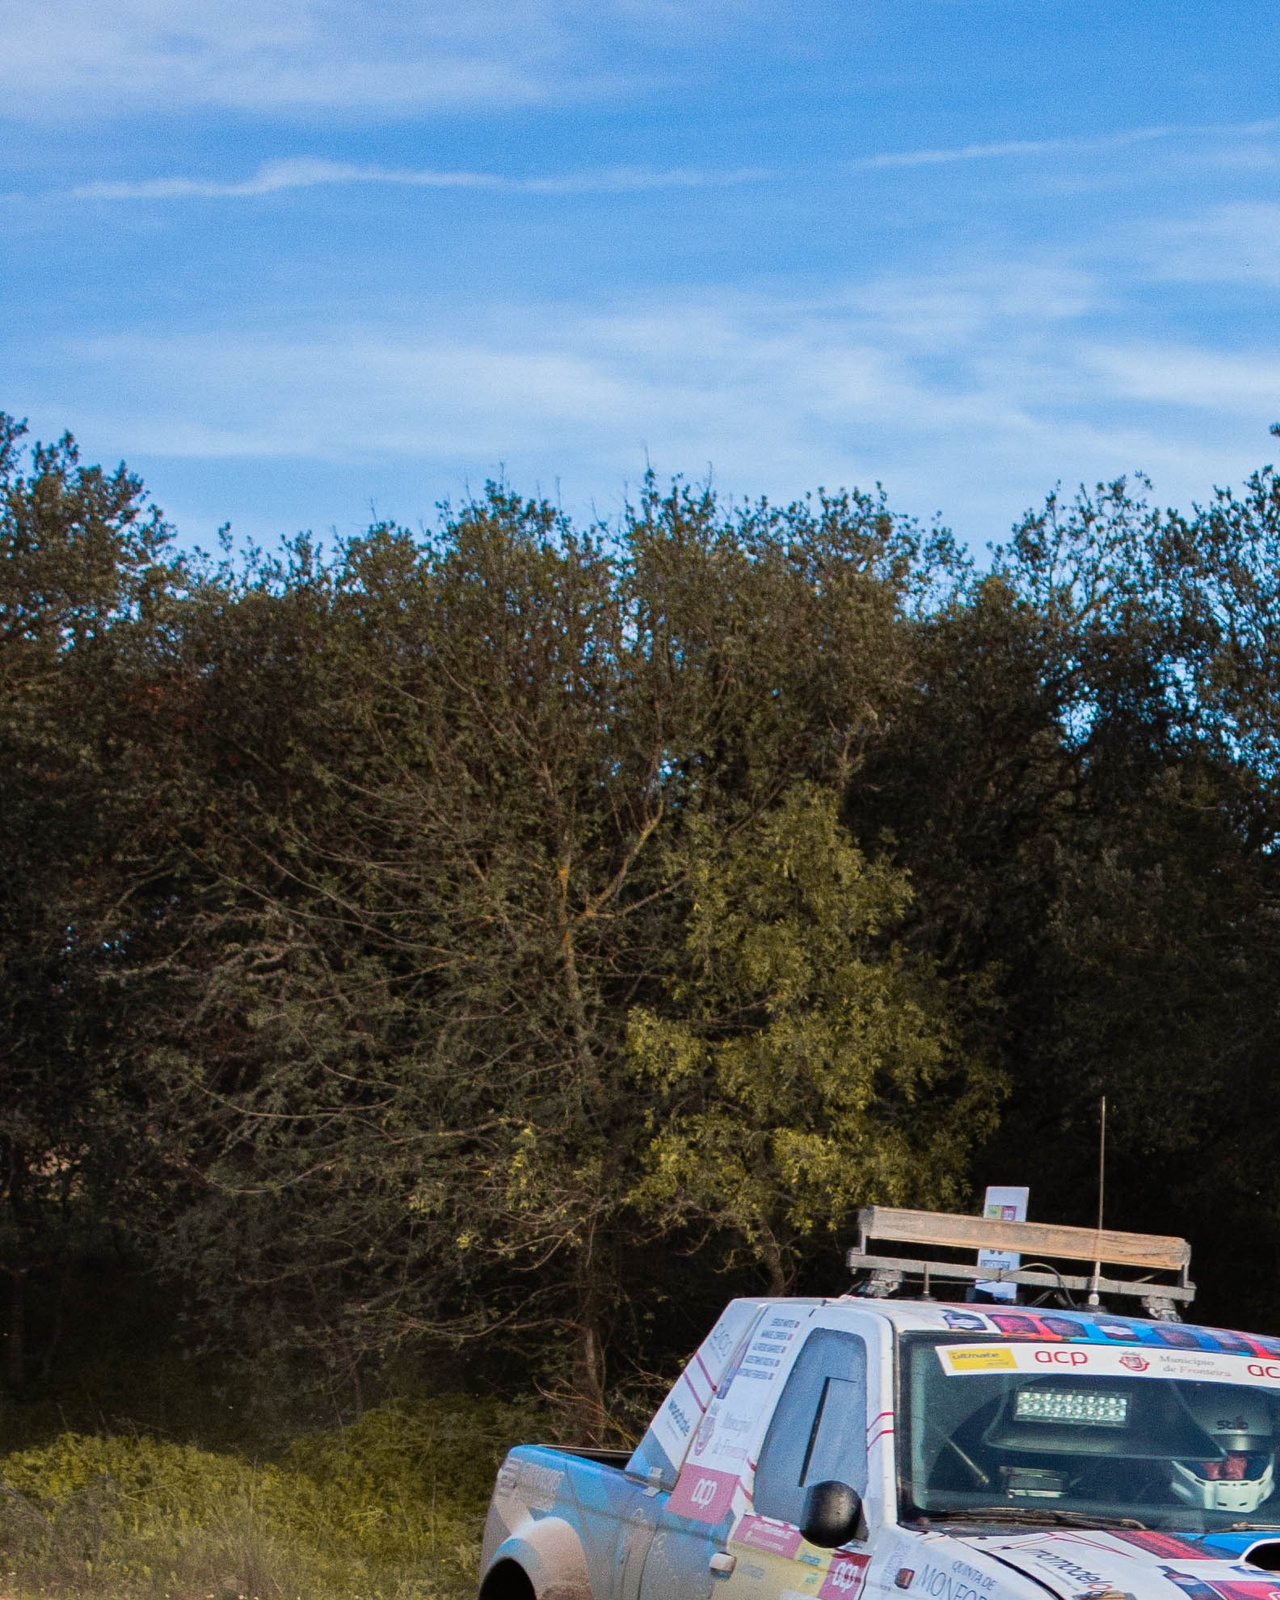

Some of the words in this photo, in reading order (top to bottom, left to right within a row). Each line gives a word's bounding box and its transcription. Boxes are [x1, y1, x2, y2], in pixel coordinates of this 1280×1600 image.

[1034, 1350, 1089, 1366] acp
[691, 1478, 718, 1510] acp
[952, 1560, 983, 1585] QUINTA
[980, 1576, 998, 1591] DE
